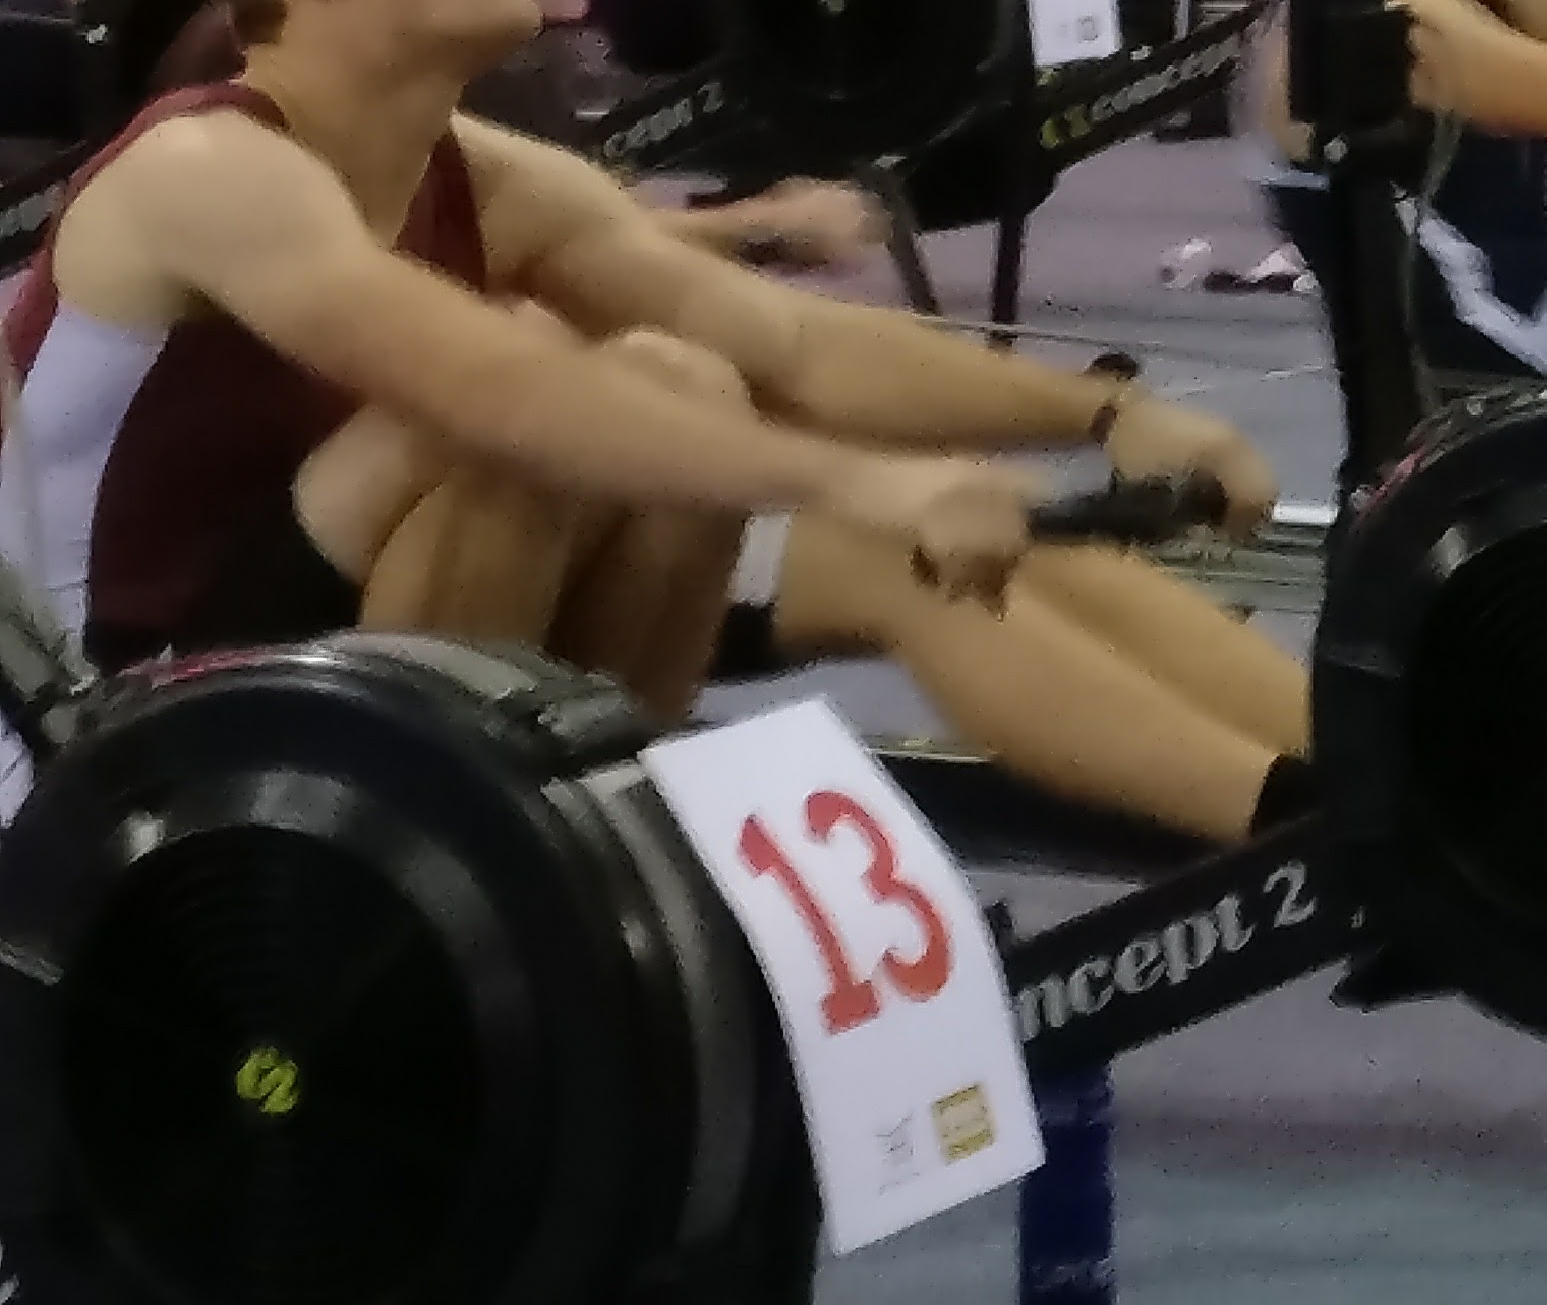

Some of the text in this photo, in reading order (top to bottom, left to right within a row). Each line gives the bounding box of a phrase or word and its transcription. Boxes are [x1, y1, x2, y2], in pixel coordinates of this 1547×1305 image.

[738, 789, 954, 1036] 13
[1014, 860, 1318, 1043] ncept 2
